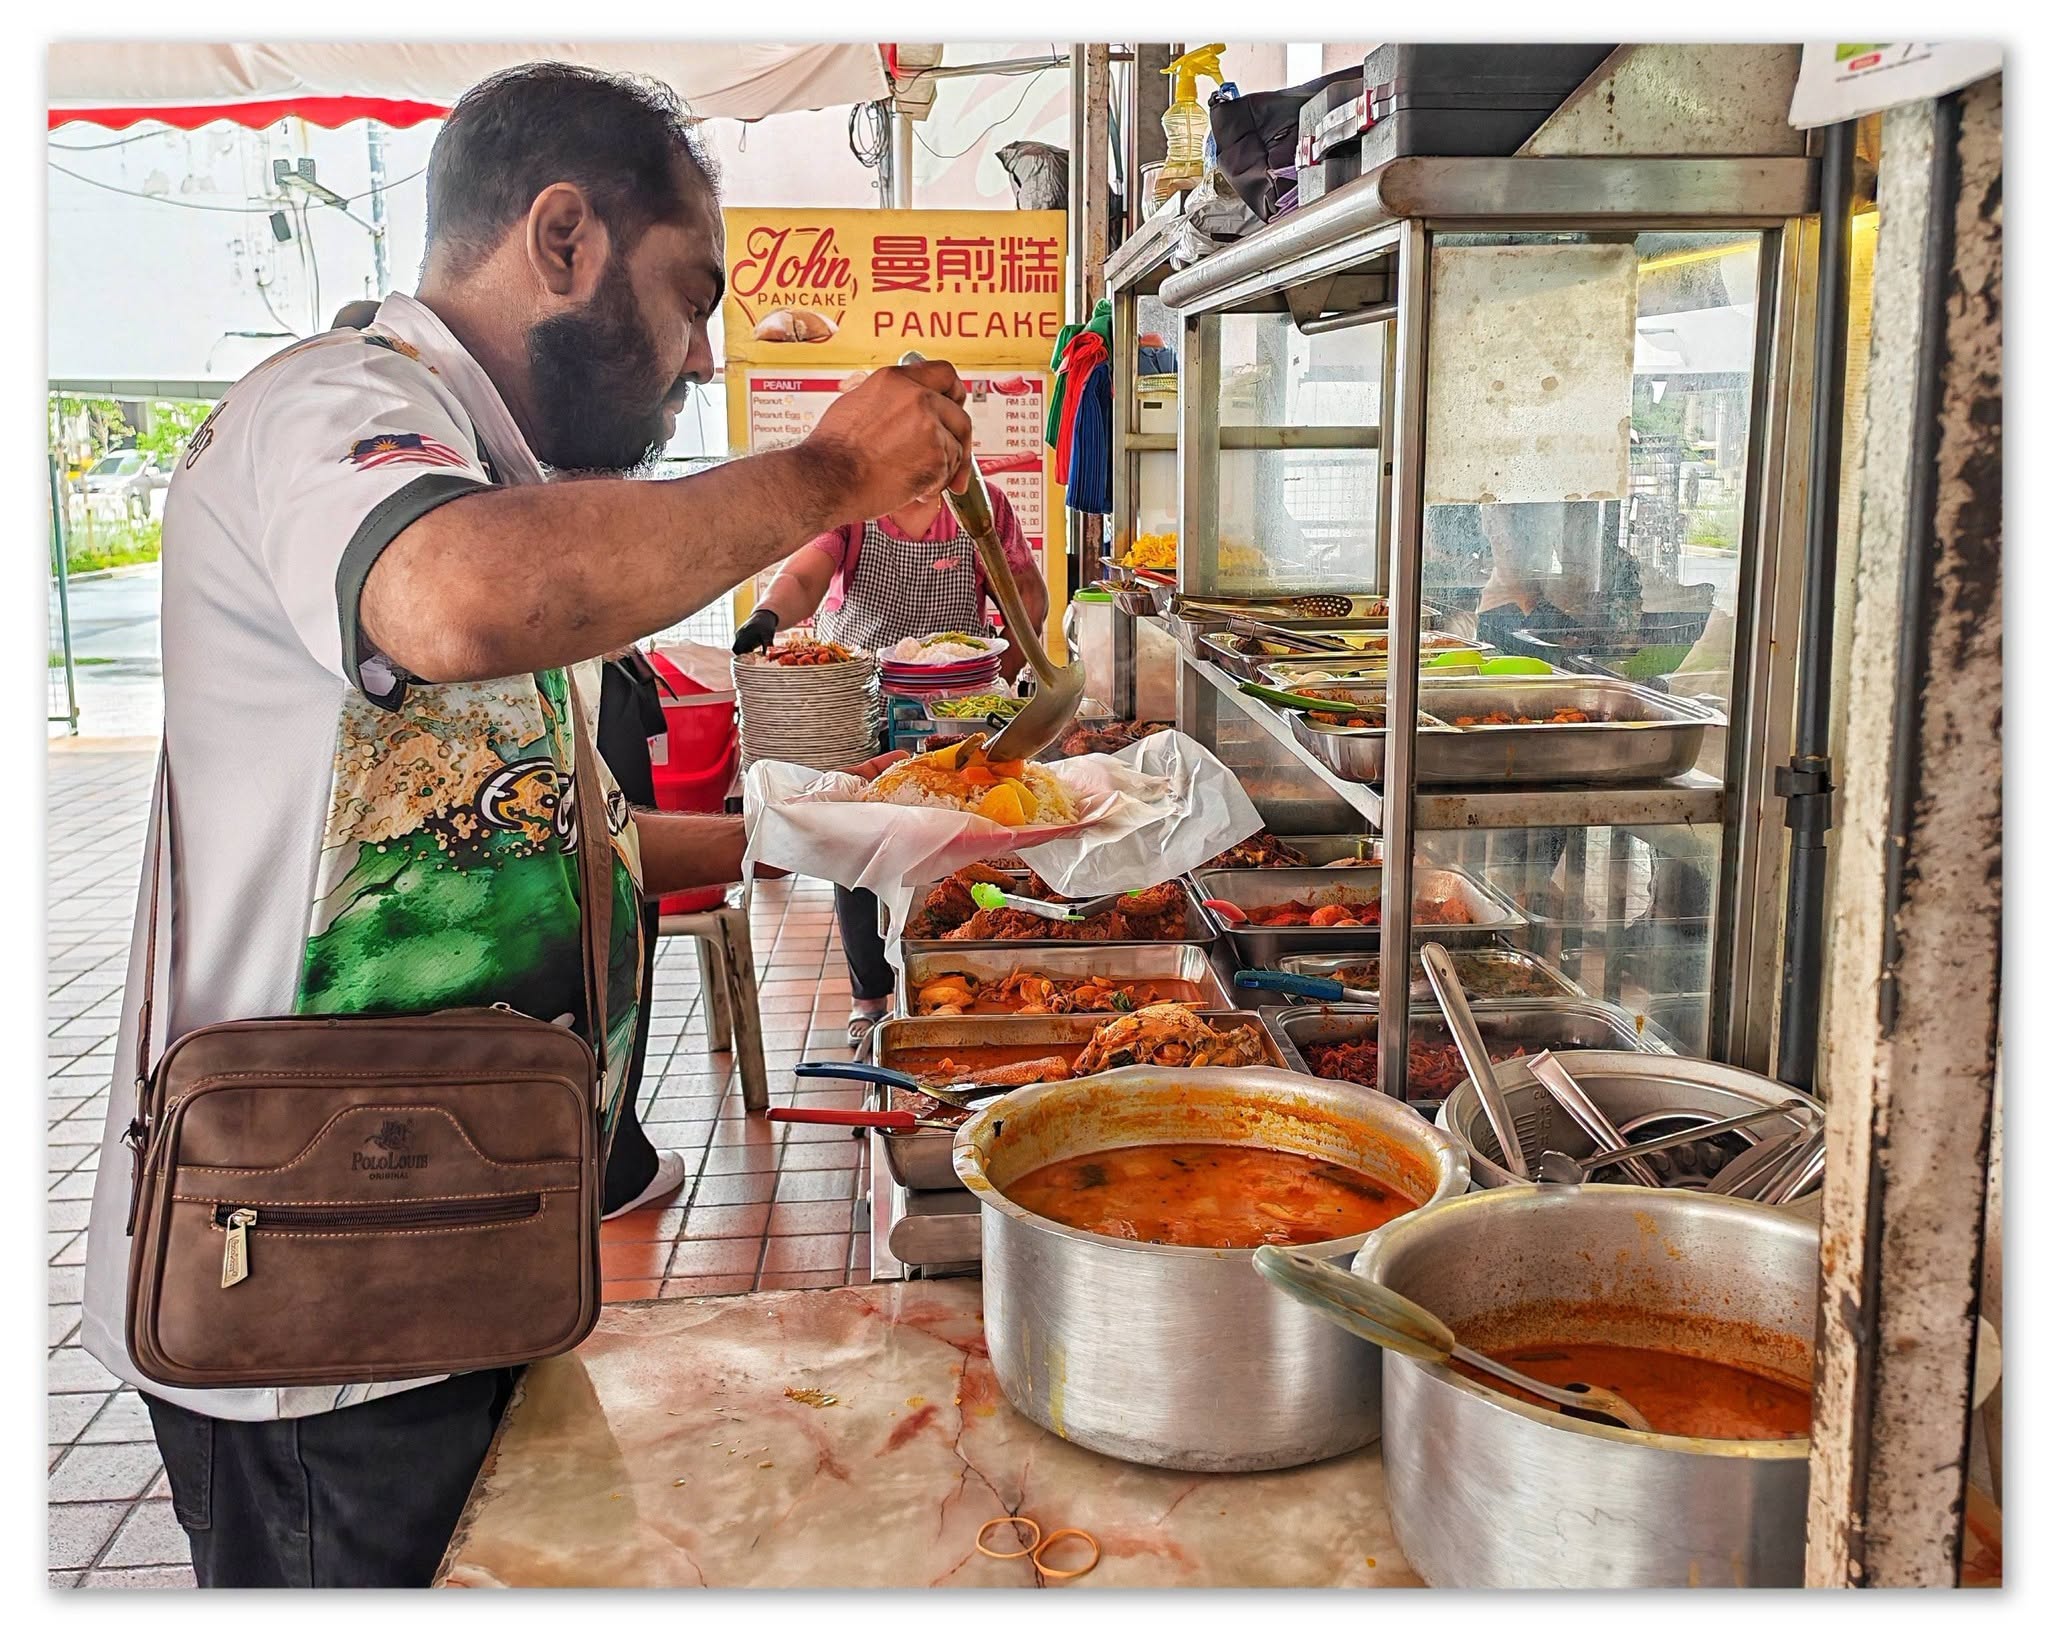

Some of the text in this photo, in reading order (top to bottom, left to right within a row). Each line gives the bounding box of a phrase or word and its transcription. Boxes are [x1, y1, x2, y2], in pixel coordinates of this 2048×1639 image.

[732, 227, 851, 297] John
[872, 236, 1058, 293] 曼煎糕
[758, 293, 847, 306] PANCAKE
[875, 311, 1058, 338] PANCAKE
[763, 381, 802, 390] PEANUT
[753, 396, 782, 405] Peanut
[1006, 398, 1039, 406] RM 3.00
[754, 410, 783, 419] Peanut
[1006, 412, 1039, 420] RM 4.00
[754, 424, 783, 433] Peanut
[368, 1172, 408, 1180] ORIGINAL
